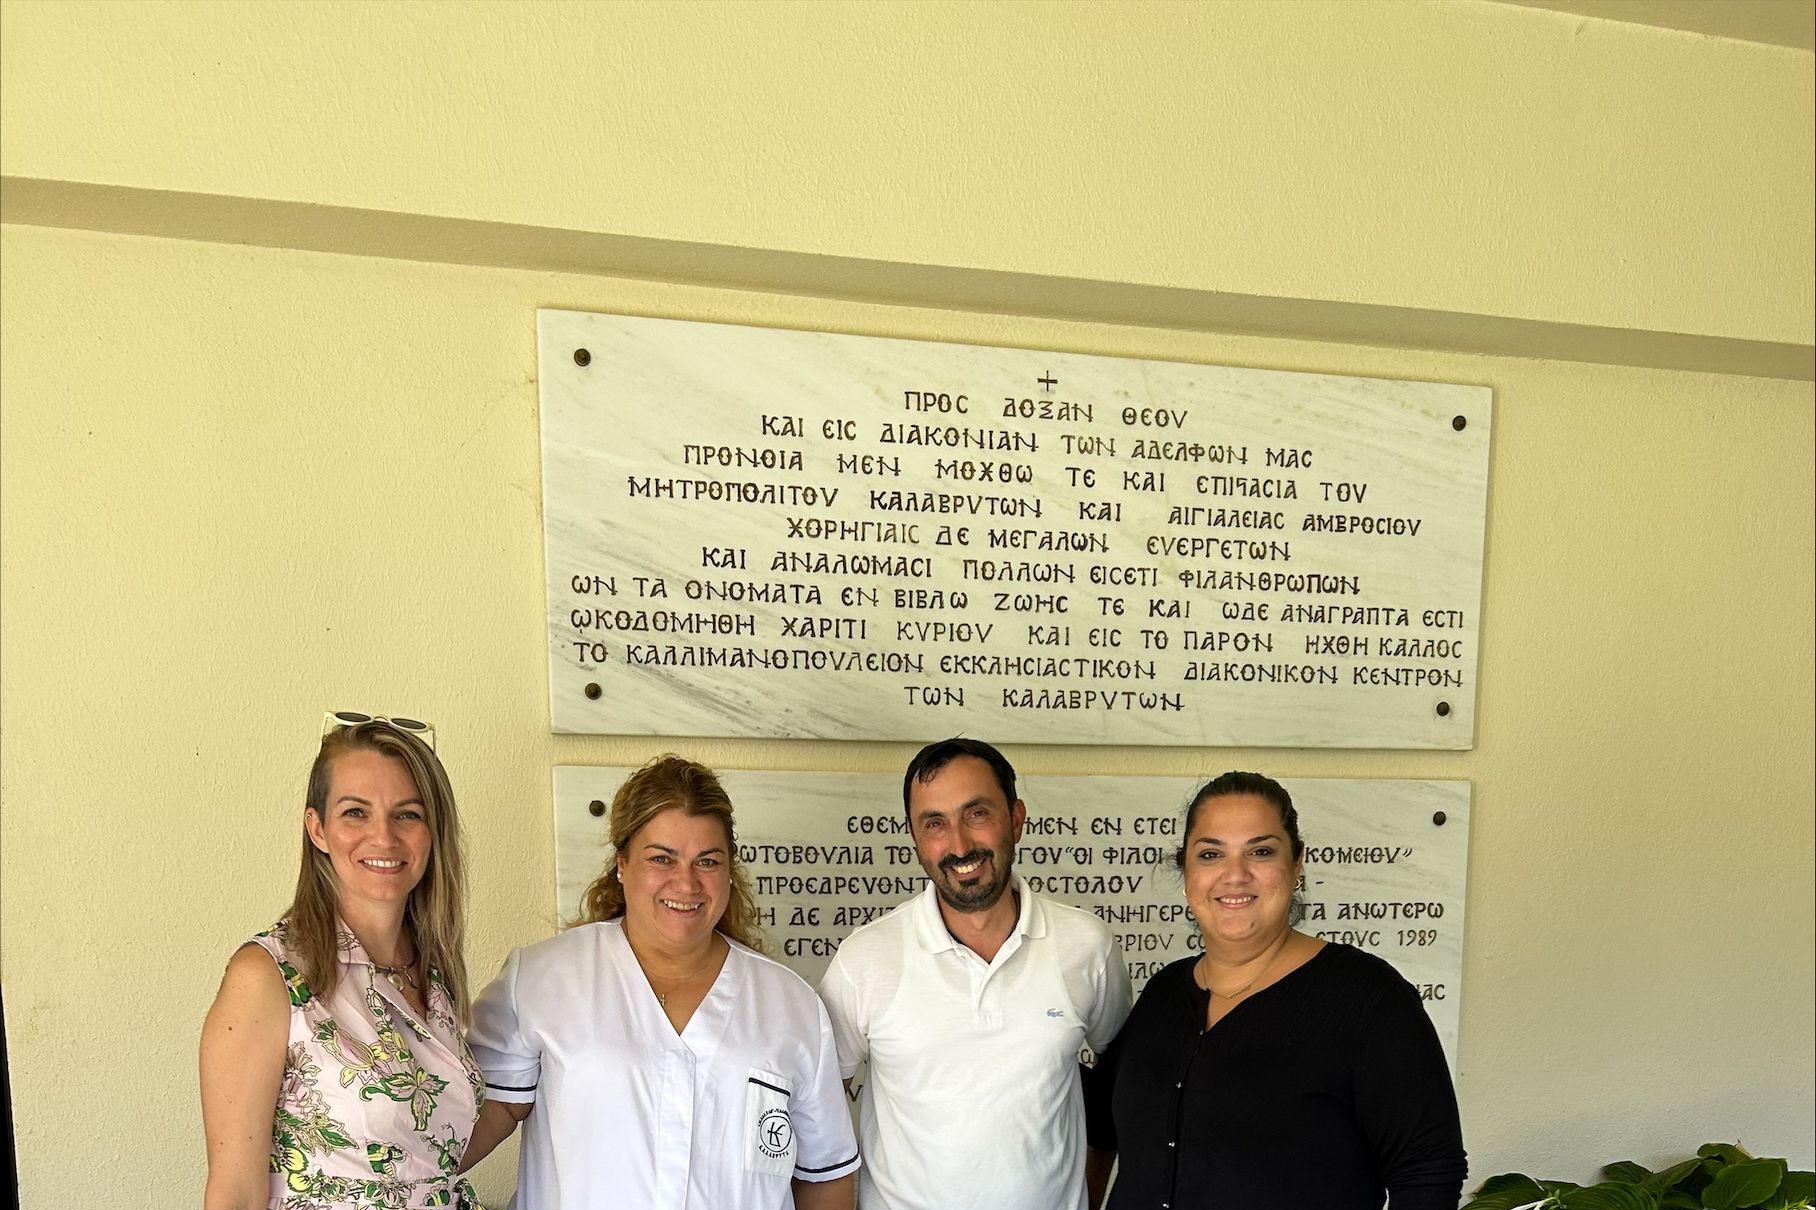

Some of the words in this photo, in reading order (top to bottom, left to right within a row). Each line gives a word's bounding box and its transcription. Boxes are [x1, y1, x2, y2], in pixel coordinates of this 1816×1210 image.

[1122, 406, 1188, 428] ΘΕΟΥ
[761, 414, 804, 438] ΚΑΙ
[879, 424, 1039, 453] ΔΙΑΚΟΝΙΑΝ
[1131, 440, 1248, 465] ΑΔΕΛΦΩΝ
[683, 444, 804, 471] ΠΡΟΝΟΙΑ
[836, 453, 901, 476] ΜΕΝ
[933, 458, 1033, 484] ΜΟΧΘΩ
[1065, 467, 1096, 489] ΤΕ
[1123, 471, 1165, 493] ΚΑΙ
[1320, 483, 1367, 504] ΤΟΥ
[627, 476, 839, 508] ΜΗΤΡΟΠΟΛΙΤΟΥ
[870, 489, 1042, 520] ΚΑΛΑΒΡΥΤΩΝ
[1079, 501, 1121, 523] ΚΑΙ
[935, 525, 969, 546] ΔΕ
[988, 529, 1109, 554] ΜΕΓΑΛΩΝ
[1146, 536, 1291, 561] ΕΥΕΡΓΕΤΩΝ
[702, 546, 746, 570] ΚΑΙ
[963, 559, 1075, 583] ΠΟΛΛΩΝ
[1179, 569, 1359, 595] ΦΙΛΑΝΘΡΩΠΩΝ
[633, 577, 667, 598] ΤΑ
[685, 580, 821, 605] ΟΝΟΜΑΤΑ
[841, 586, 879, 607] ΕΝ
[894, 587, 967, 609] ΒΙΒΛΩ
[1098, 597, 1124, 616] ΤΕ
[1148, 598, 1190, 618] ΚΑΙ
[1223, 602, 1269, 622] ΩΔΕ
[1280, 604, 1409, 627] ΑΝΑΓΡΑΠΤΑ
[780, 616, 866, 640] ΧΑΡΙΤΙ
[896, 621, 993, 644] ΚΥΡΙΟΥ
[1028, 626, 1070, 647] ΚΑΙ
[1140, 630, 1169, 650] ΤΟ
[1183, 631, 1273, 654] ΠΑΡΟΝ
[573, 642, 608, 664] ΤΟ
[1183, 661, 1338, 685] ΔΙΑΚΟΝΙΚΟΝ
[1353, 667, 1464, 688] ΚΕΝΤΡΟΝ
[904, 686, 965, 707] ΤΩΝ
[1002, 688, 1185, 711] ΚΑΛΑΒΡΥΤΩΝ
[1091, 817, 1122, 835] ΕΝ
[1133, 817, 1176, 835] ΕΤΕΙ
[739, 845, 874, 865] ΩΤΟΒΟΥΛΙΑ
[756, 876, 930, 895] ΠΡΟΕΔΡΕΥΟΝΤ
[789, 907, 820, 926] ΔΕ
[1337, 903, 1444, 921] ΑΝΩΤΕΡΩ
[1397, 930, 1437, 946] 1989
